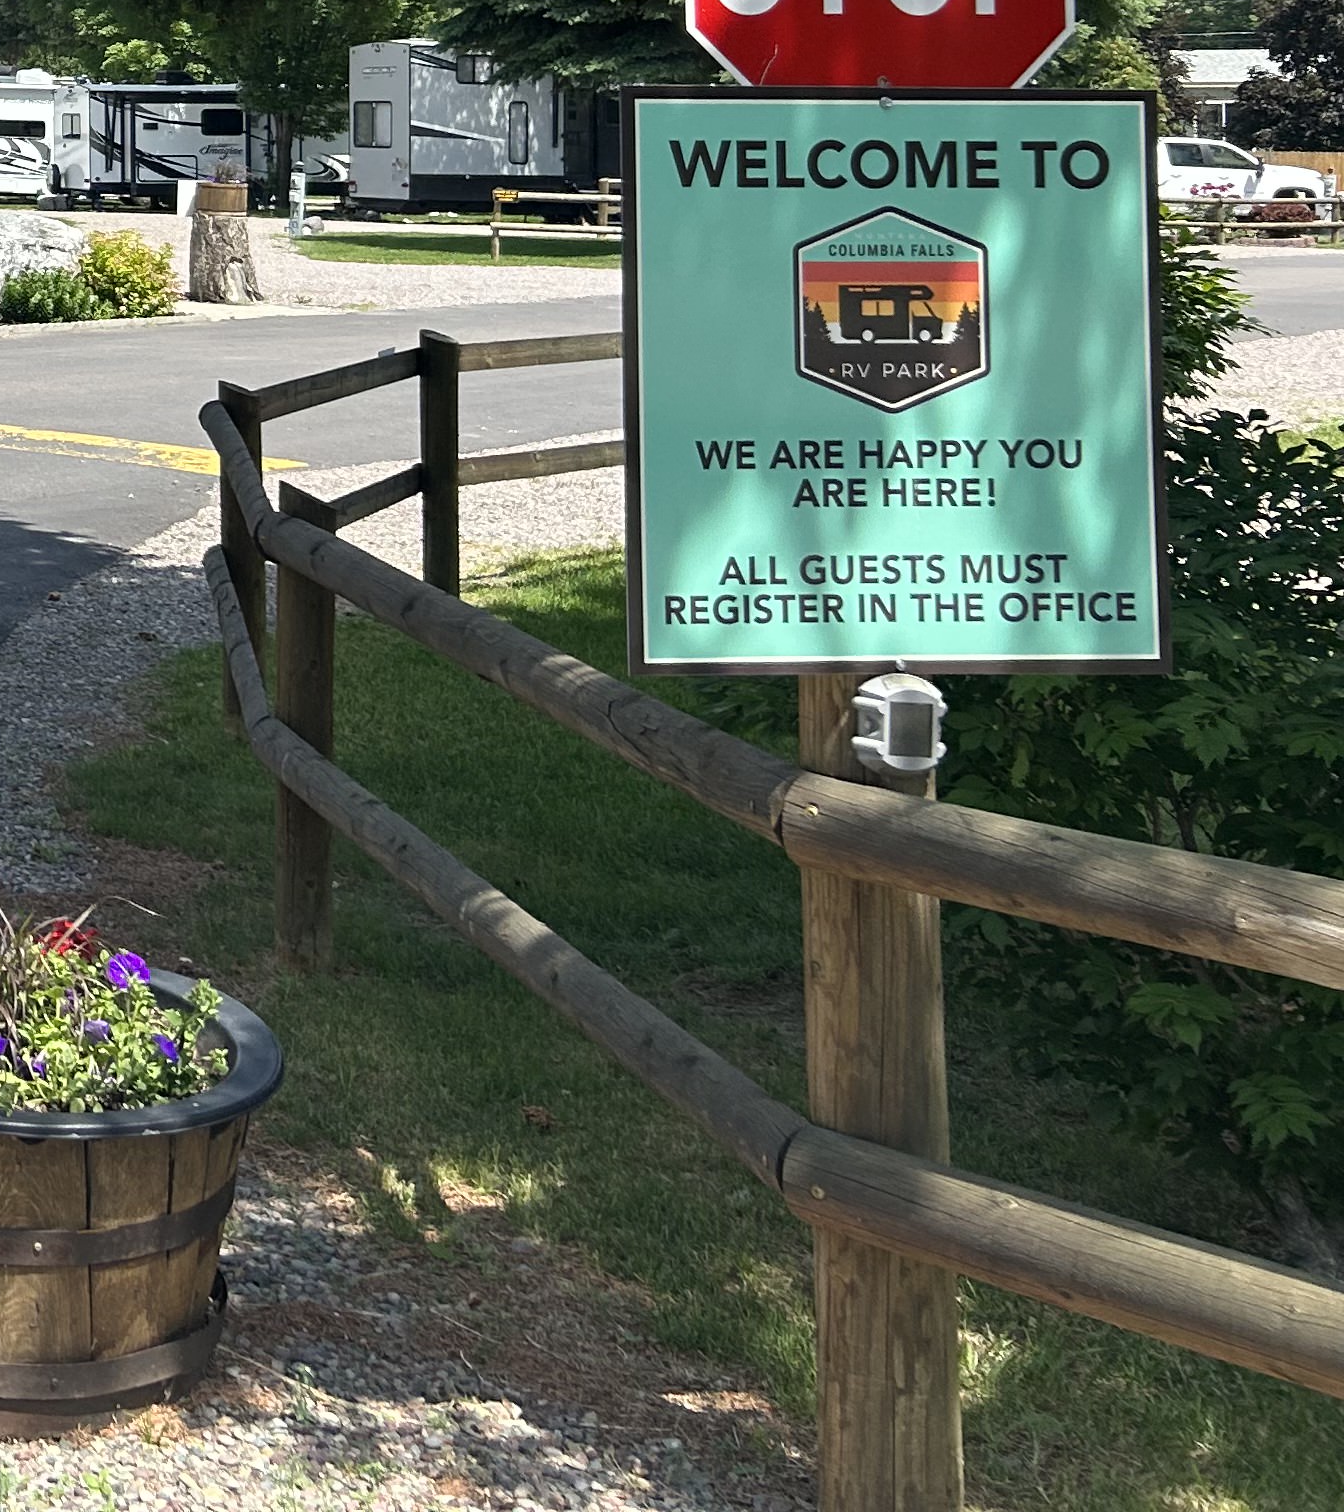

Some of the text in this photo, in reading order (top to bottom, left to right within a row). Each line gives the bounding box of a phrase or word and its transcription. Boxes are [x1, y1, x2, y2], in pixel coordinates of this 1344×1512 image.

[669, 138, 1111, 190] WELCOME TO
[828, 244, 955, 257] COLUMBIA FALLS
[841, 362, 945, 379] RV PARK
[696, 438, 1083, 471] WE ARE HAPPY YOU
[792, 477, 997, 508] ARE HERE!
[719, 554, 1068, 586] ALL GUESTS MUST
[664, 591, 1138, 626] REGISTER IN THE OFFICE
